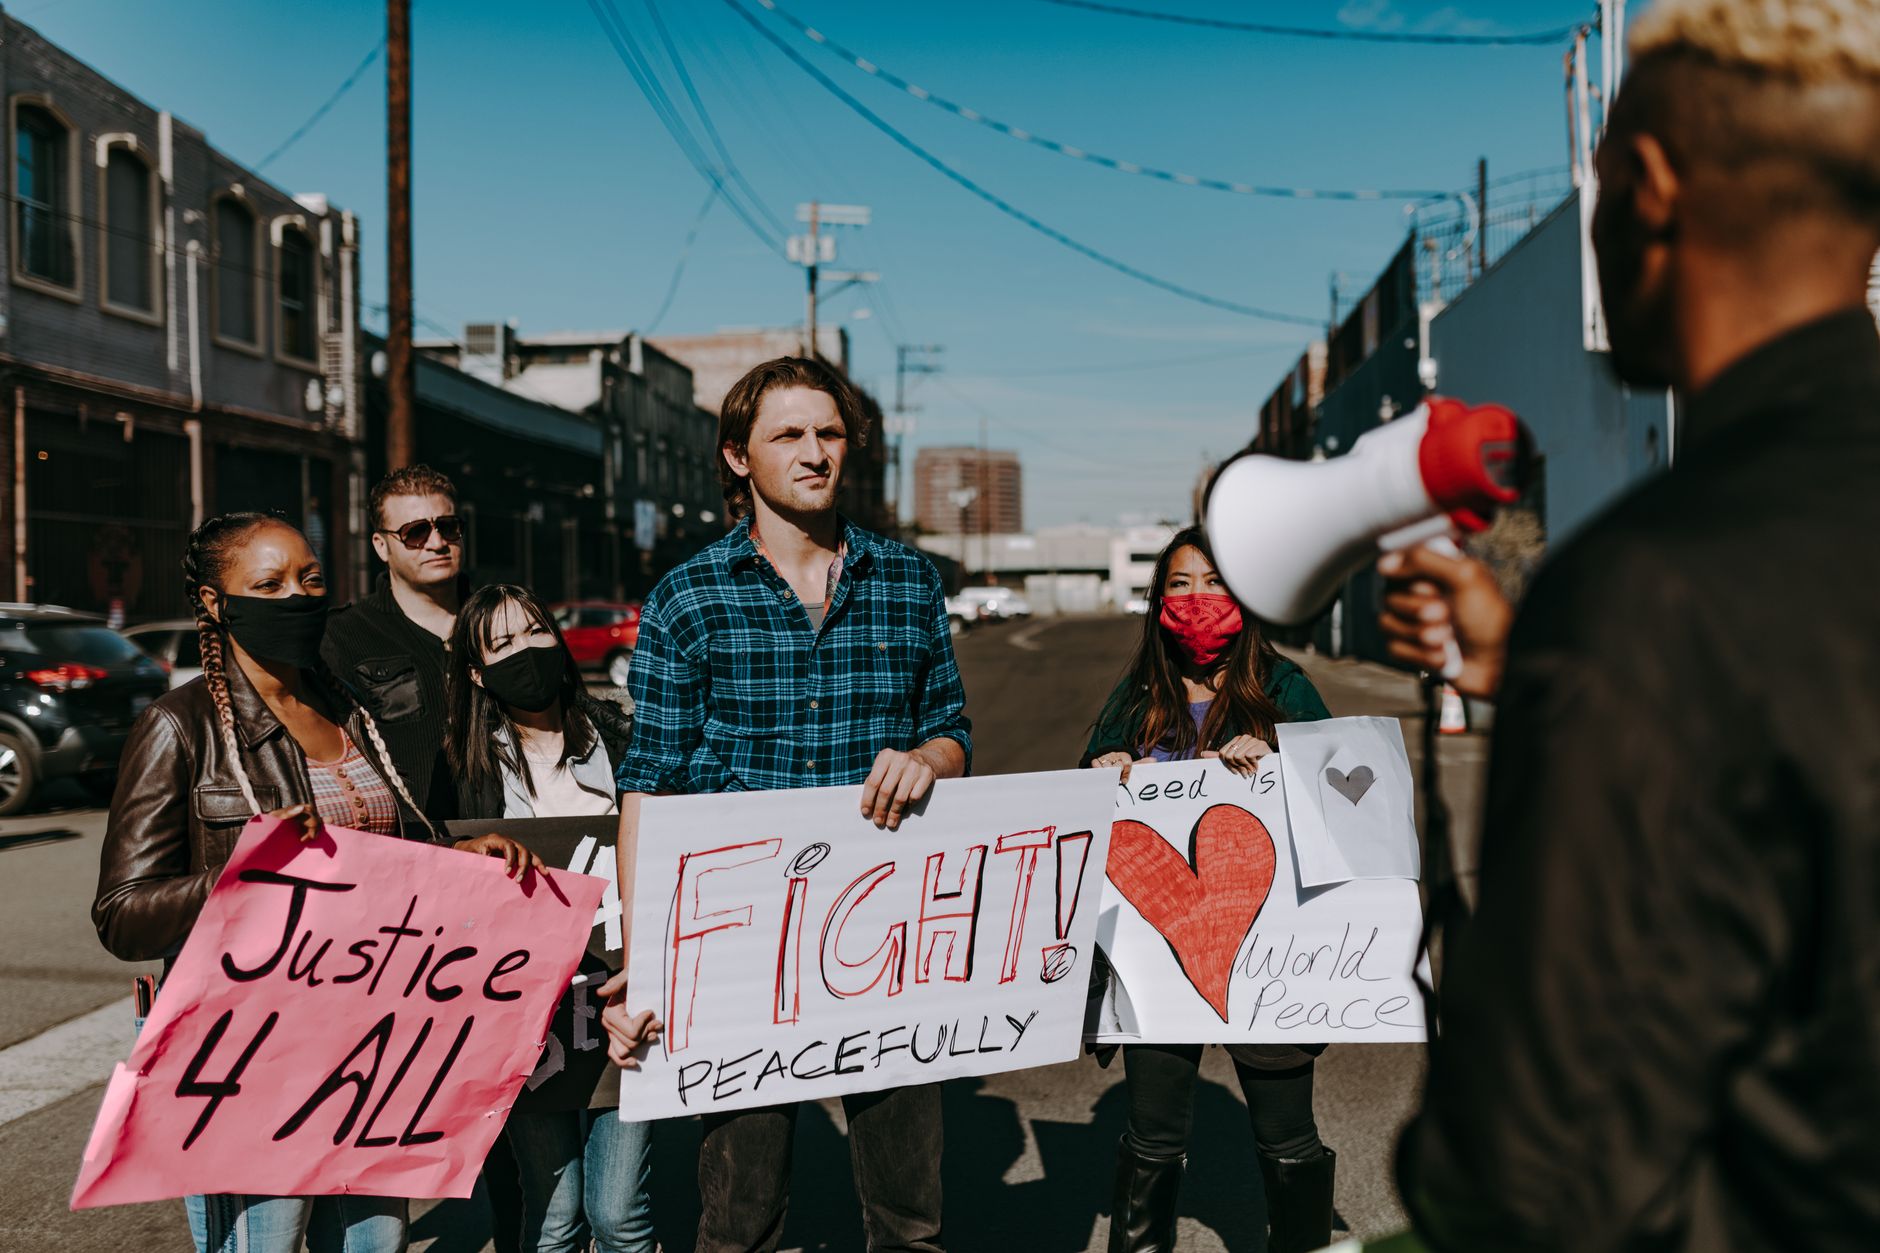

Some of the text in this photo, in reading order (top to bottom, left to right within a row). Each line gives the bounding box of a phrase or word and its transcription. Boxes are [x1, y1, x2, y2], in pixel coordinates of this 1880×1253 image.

[221, 869, 530, 1003] Justice
[1236, 922, 1391, 981] World
[1248, 979, 1424, 1031] Peace
[175, 1009, 280, 1151] 4
[272, 1011, 475, 1148] ALL
[678, 1010, 1039, 1106] PEACEFULLY
